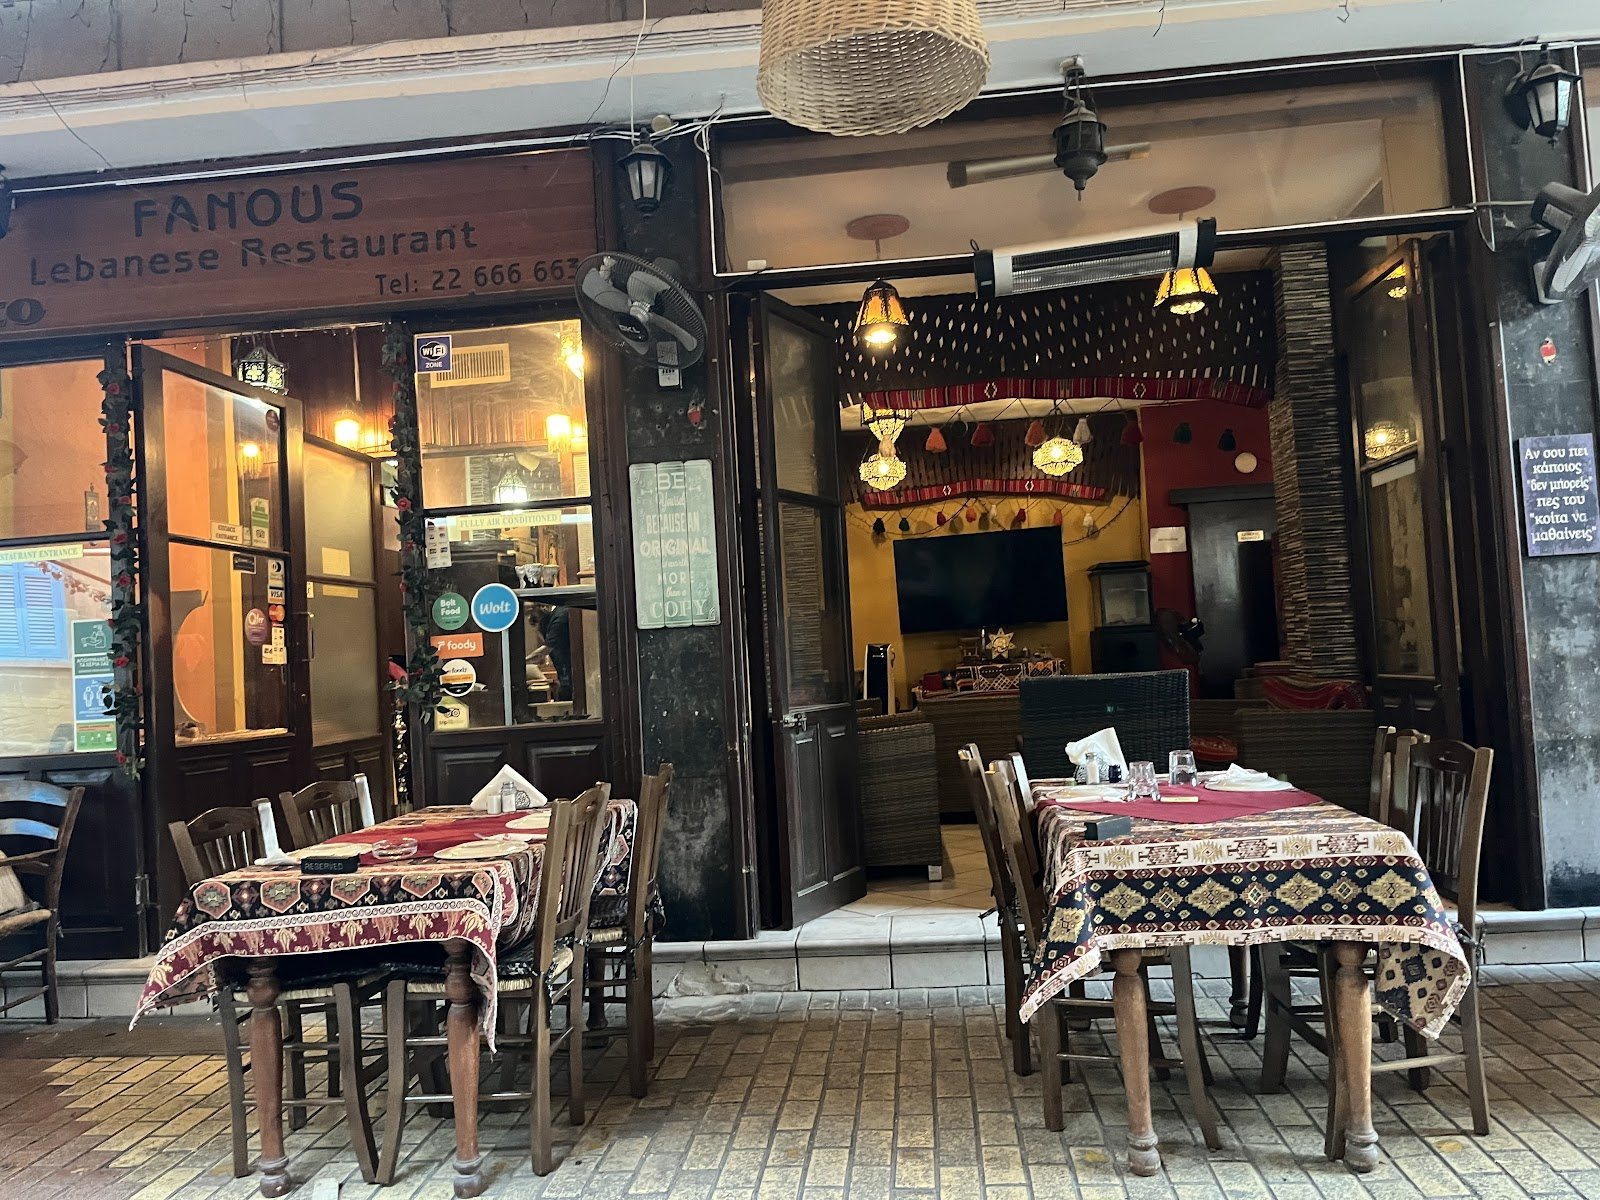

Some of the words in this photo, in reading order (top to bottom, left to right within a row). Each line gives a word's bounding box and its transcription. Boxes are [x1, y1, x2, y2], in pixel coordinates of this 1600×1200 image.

[30, 248, 219, 286] Lebanese
[241, 221, 478, 268] Restaurant
[375, 272, 419, 296] Tel:
[432, 268, 463, 291] 22
[474, 262, 522, 288] 666
[1543, 449, 1565, 459] σου
[1569, 447, 1588, 457] πει
[1533, 462, 1582, 474] κάποιος
[657, 471, 686, 491] BE
[1536, 496, 1559, 509] πες
[1563, 495, 1585, 505] του
[460, 519, 485, 528] FULLY
[487, 517, 501, 526] AIR
[503, 513, 557, 525] CONDITIONED
[646, 512, 686, 535] BECAUSE
[687, 511, 700, 533] AN
[1571, 512, 1587, 522] να
[39, 547, 78, 558] ENTRANCE
[640, 536, 711, 557] ORIGINAL
[657, 570, 694, 586] MORE
[271, 590, 283, 598] VISA
[440, 599, 456, 608] Bolt
[480, 601, 511, 615] Wolt
[651, 598, 708, 619] COPY
[441, 607, 460, 616] Food
[447, 639, 476, 651] foody
[304, 862, 343, 870] RESERVED
